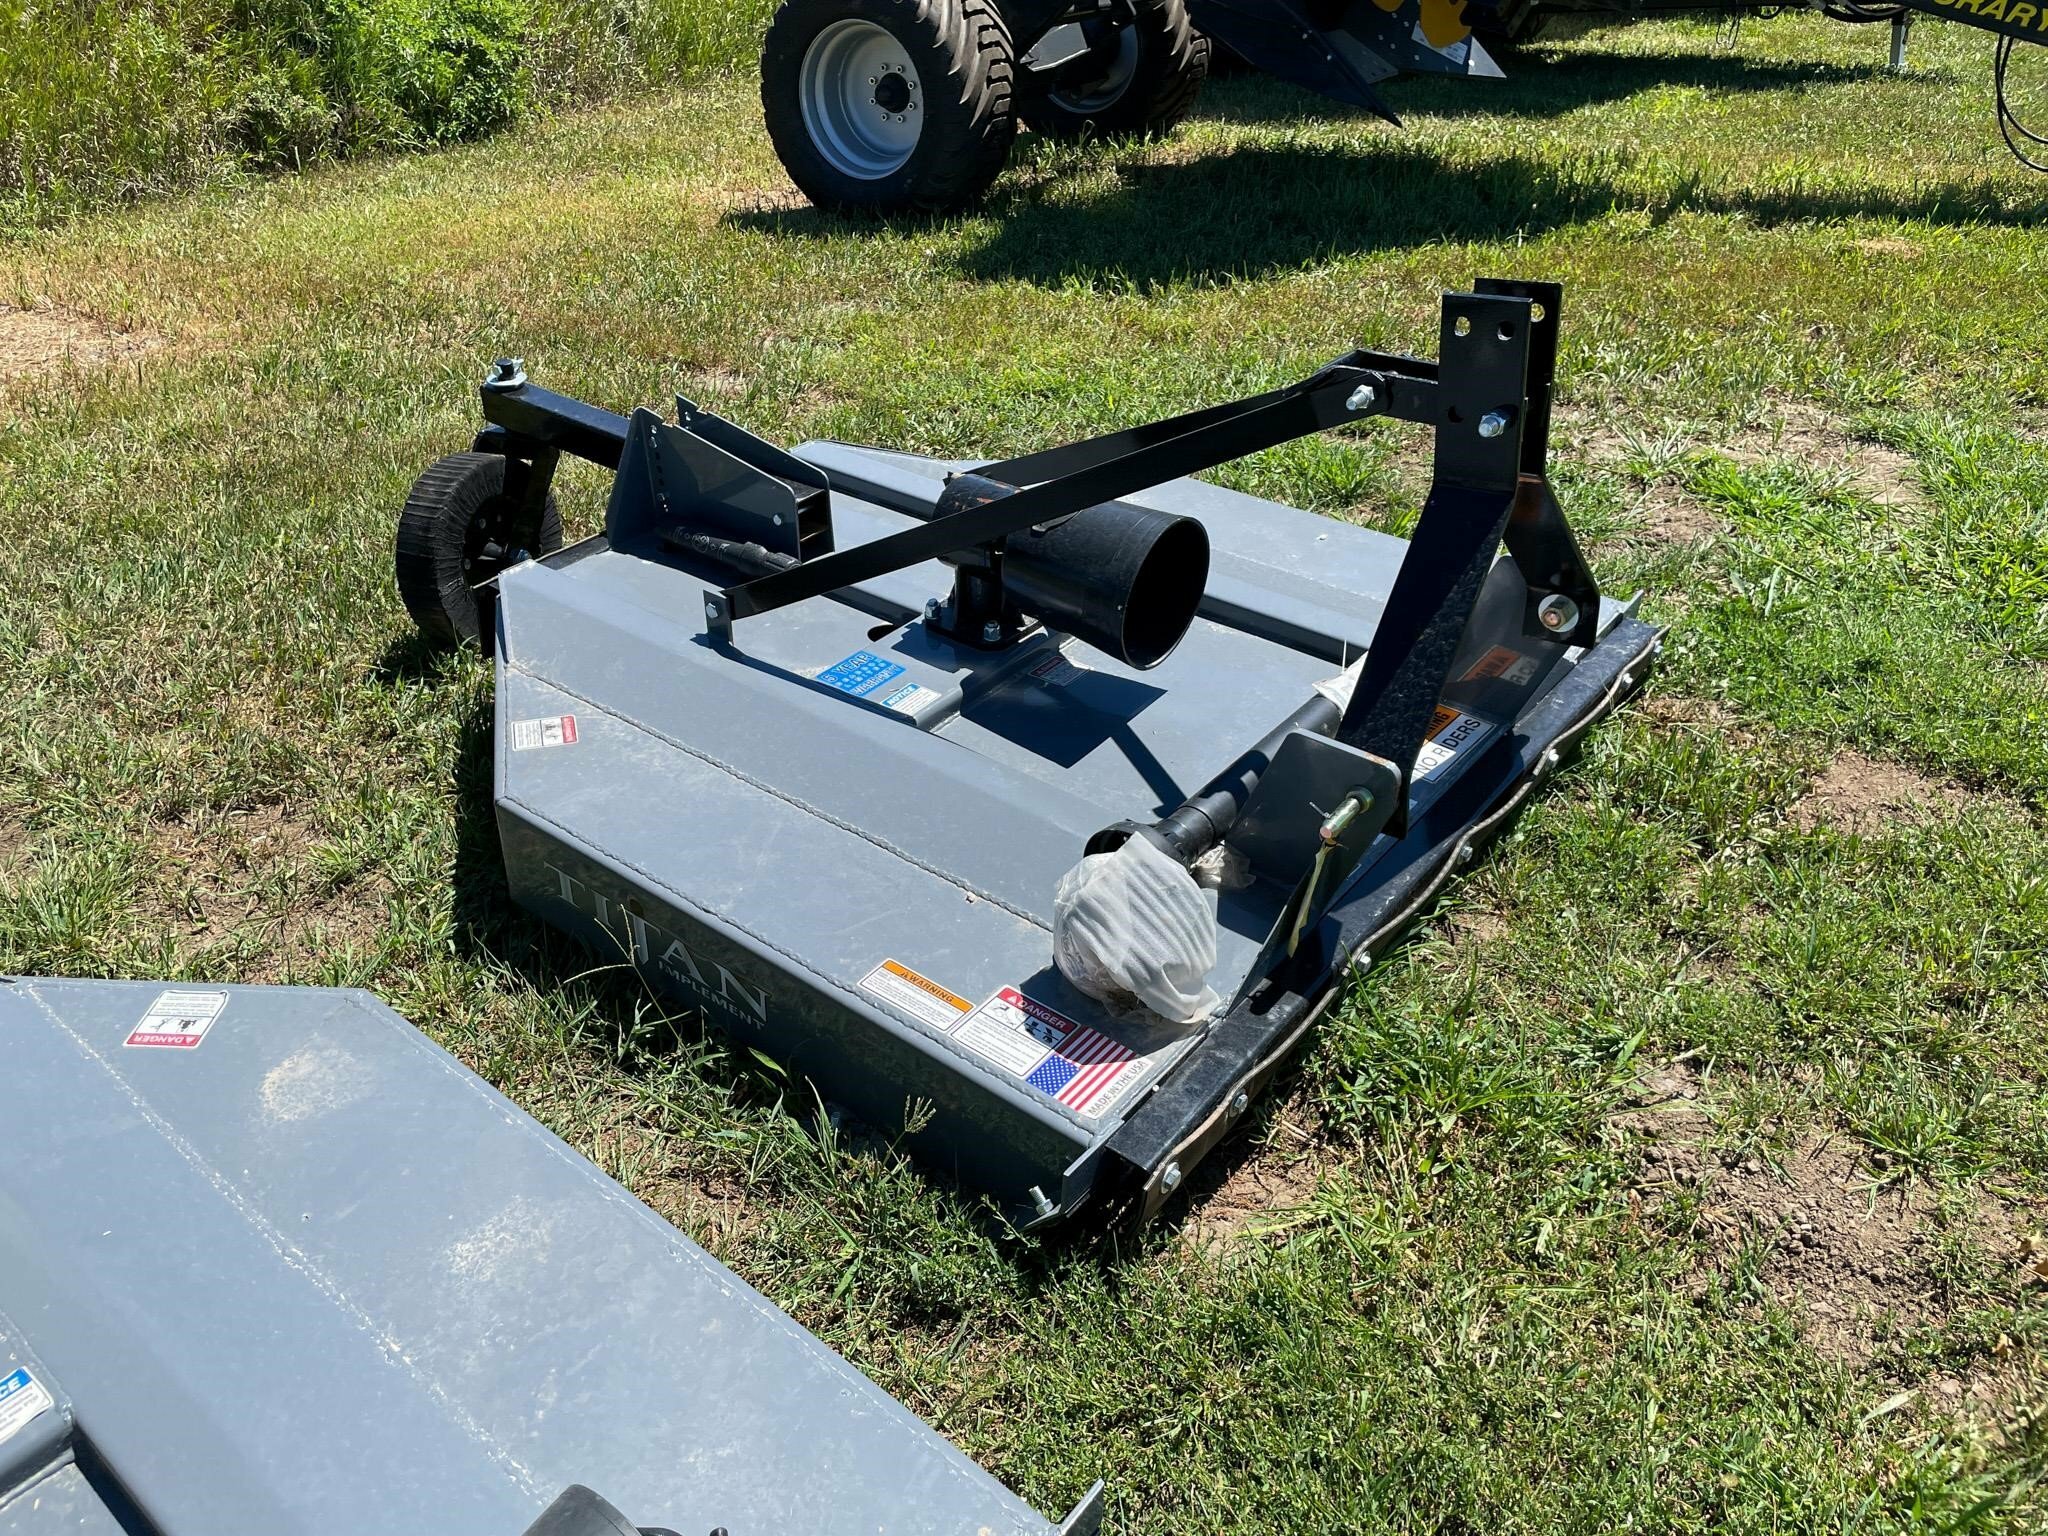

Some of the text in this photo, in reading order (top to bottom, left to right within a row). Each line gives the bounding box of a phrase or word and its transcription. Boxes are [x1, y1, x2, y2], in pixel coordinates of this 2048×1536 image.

[886, 686, 915, 706] NOTICE
[1413, 719, 1481, 775] NO RIDERS
[543, 861, 771, 1022] TITAN
[658, 962, 765, 1030] IMPLEMENT
[908, 974, 954, 1003] WARNING
[1018, 998, 1067, 1029] DANGER
[133, 1035, 184, 1043] DANGER
[1087, 1058, 1146, 1115] MADE IN THE USA
